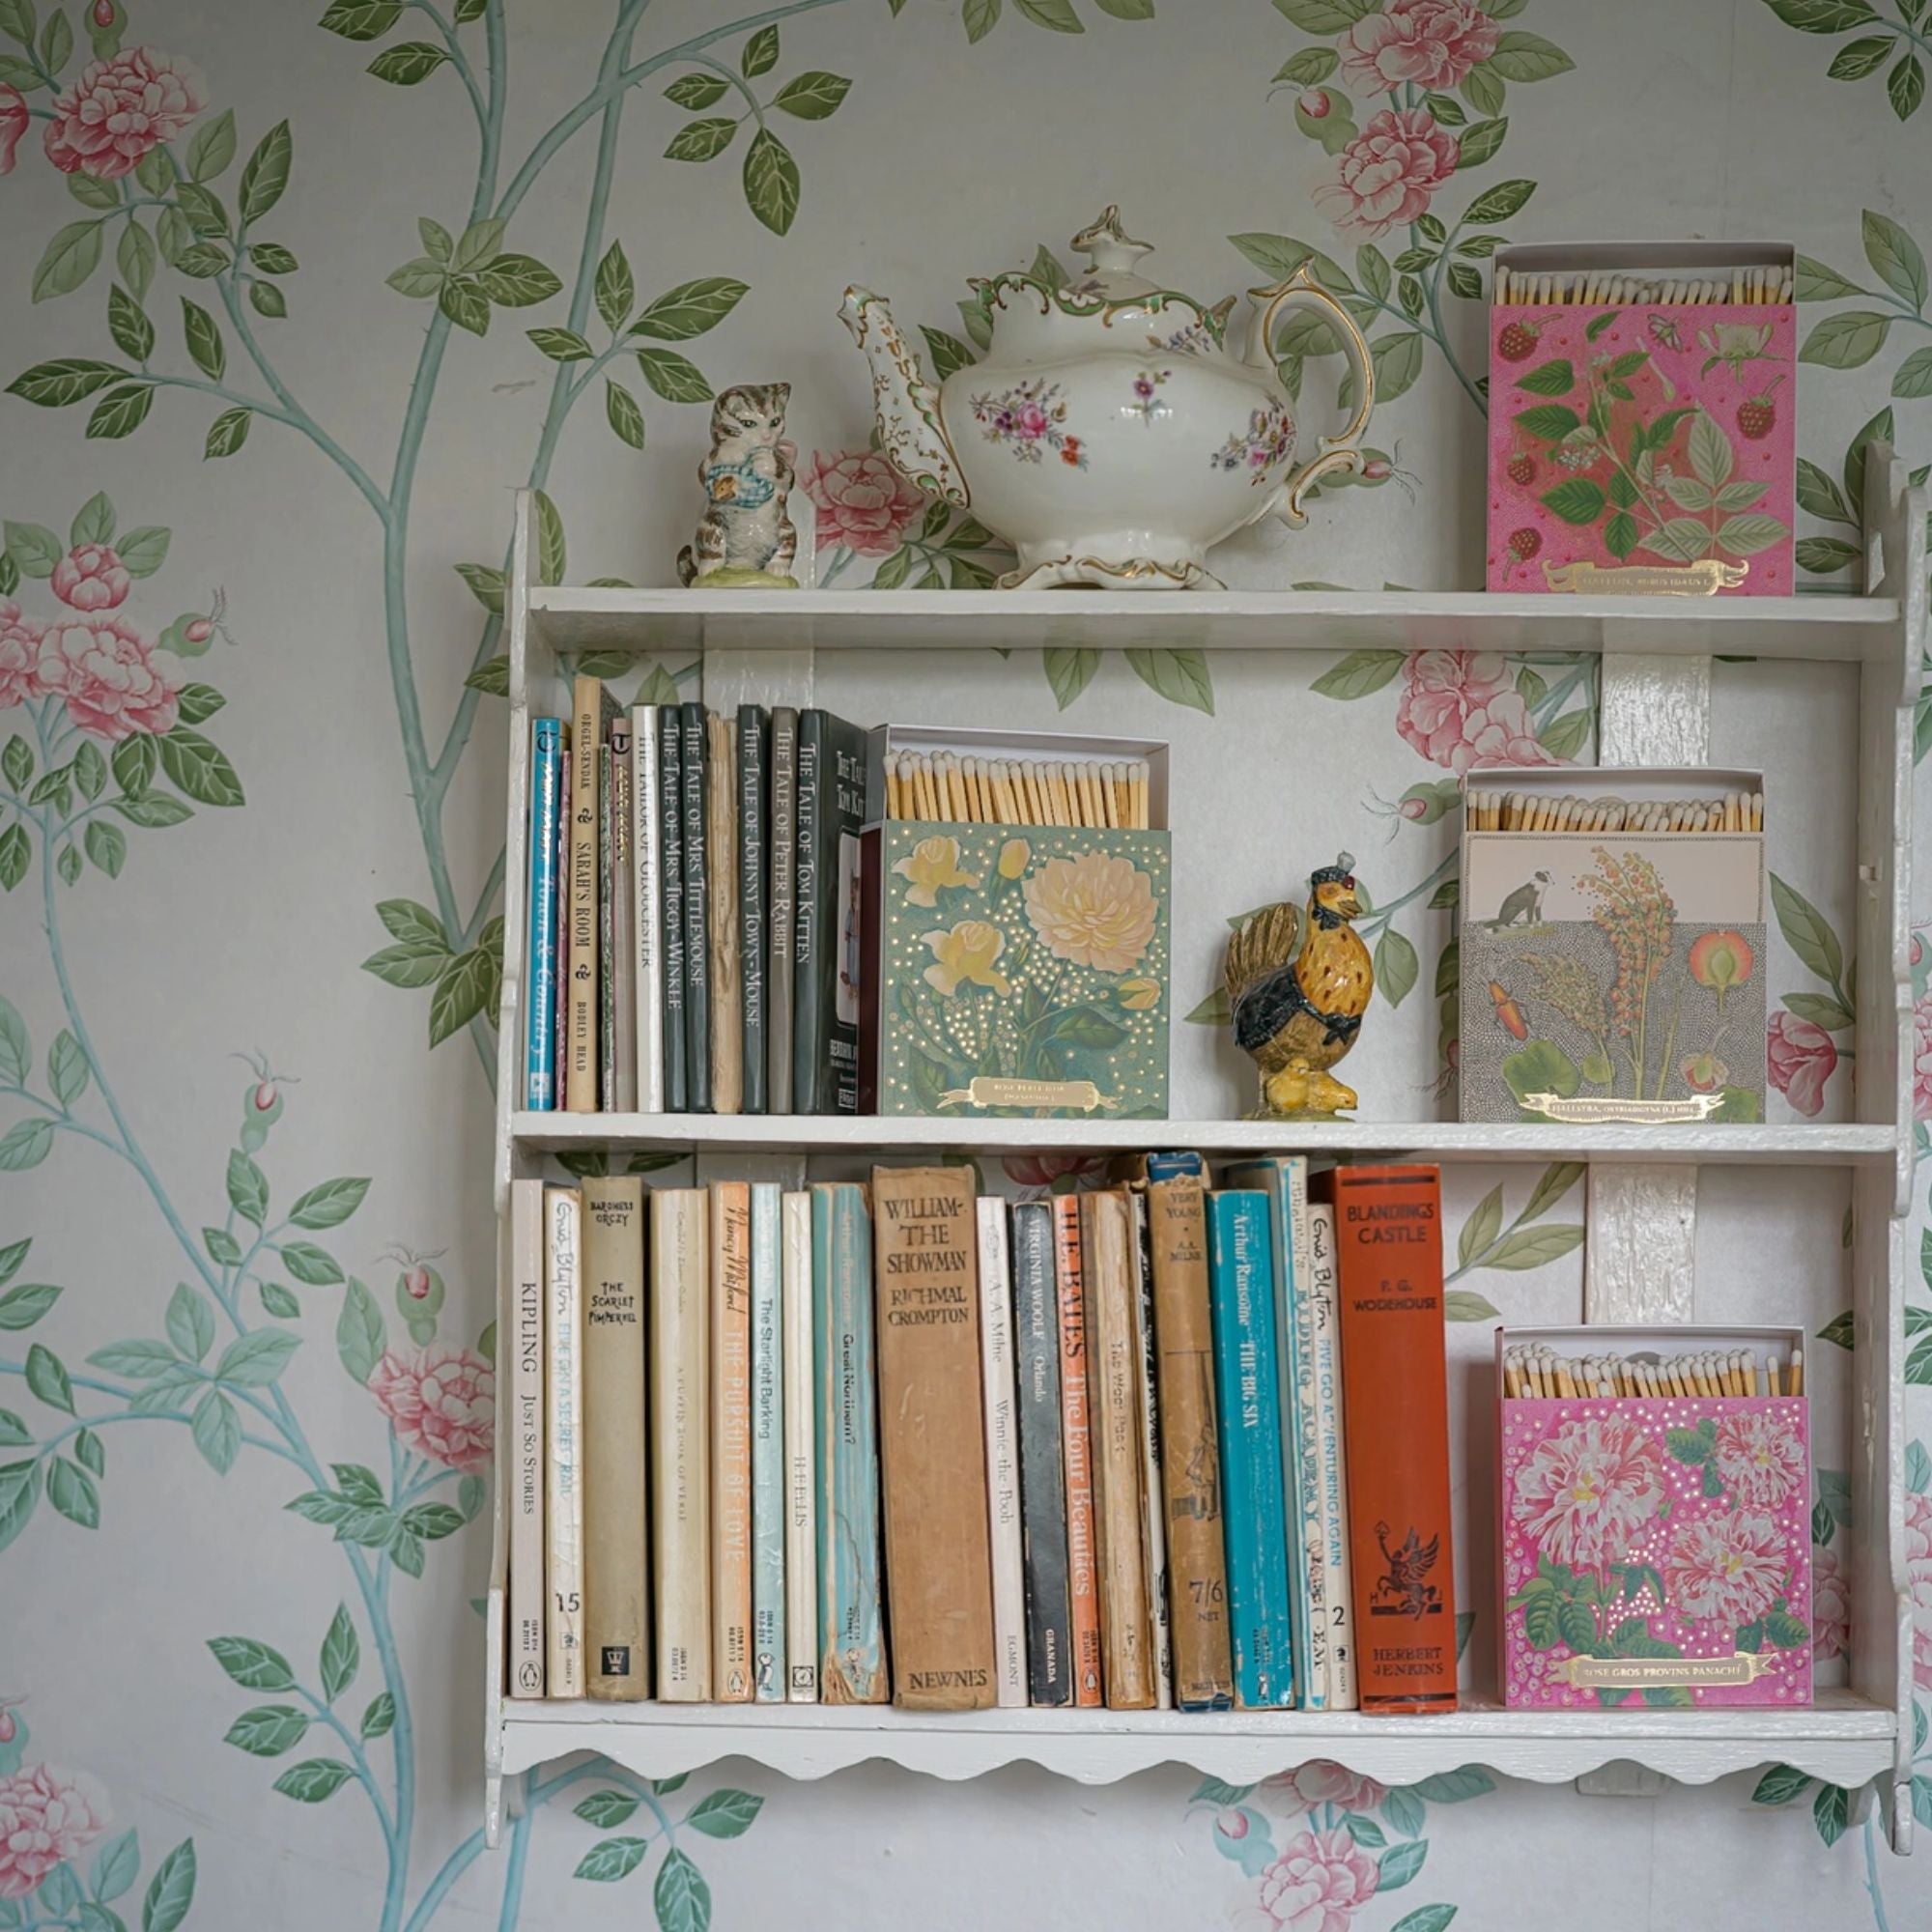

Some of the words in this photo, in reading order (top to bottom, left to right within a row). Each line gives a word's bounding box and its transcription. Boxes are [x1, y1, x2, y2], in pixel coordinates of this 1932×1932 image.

[580, 713, 591, 789] ORGEL-SENDAK
[638, 732, 655, 766] THE
[664, 724, 680, 757] THE
[687, 723, 703, 756] THE
[744, 724, 761, 758] THE
[776, 726, 793, 761] THE
[798, 743, 816, 777] THE
[639, 772, 655, 828] TAILOR
[664, 762, 680, 805] TALE
[687, 760, 703, 803] TALE
[744, 763, 761, 806] TALE
[776, 765, 793, 808] TALE
[664, 810, 678, 833] OF
[688, 809, 701, 832] OF
[745, 811, 758, 834] OF
[798, 781, 816, 826] TALE
[639, 833, 652, 852] OF
[776, 813, 791, 836] OF
[798, 831, 812, 854] OF
[576, 842, 591, 901] SARAH'S
[744, 837, 761, 908] JOHNNY
[775, 840, 791, 891] PETER
[797, 860, 815, 894] TOM
[575, 907, 591, 947] ROOM
[639, 861, 653, 968] GLOUCESTER
[689, 877, 705, 987] TITTLEMOUSE
[771, 898, 791, 958] RABBIT
[797, 900, 814, 964] KITTEN
[666, 882, 683, 1009] TIGGY-WINKLE
[739, 909, 762, 1028] TOWN-MOUSE
[529, 968, 554, 1057] Country
[577, 1001, 586, 1038] BODLEY
[576, 1046, 586, 1072] HEAD
[589, 1201, 634, 1212] BARONESS
[1170, 1191, 1199, 1204] VERY
[1347, 1203, 1435, 1222] BLANDINGS
[556, 1201, 573, 1246] Enid
[595, 1213, 629, 1227] ORCZY
[723, 1206, 749, 1254] Nancy
[897, 1224, 950, 1246] THE
[1233, 1213, 1249, 1264] Arthur
[1313, 1217, 1328, 1259] Enid
[1357, 1226, 1428, 1244] CASTLE
[886, 1250, 968, 1274] SHOWMAN
[1028, 1218, 1043, 1286] VIRGINIA
[551, 1253, 575, 1316] Blyton
[591, 1295, 636, 1310] SCARLET
[600, 1281, 624, 1295] THE
[723, 1255, 750, 1315] Mitford
[890, 1286, 967, 1306] RICHMAL
[1236, 1264, 1253, 1326] Ransome
[1311, 1267, 1332, 1331] Blyton
[1352, 1296, 1438, 1312] WODEHOUSE
[522, 1282, 538, 1374] KIPLING
[587, 1310, 638, 1325] PIMPERNEL
[760, 1298, 773, 1324] The
[887, 1307, 969, 1326] CROMPTON
[1031, 1287, 1045, 1341] WOOLF
[1062, 1270, 1085, 1358] BATES
[724, 1330, 745, 1366] THE
[758, 1327, 774, 1384] Starlight
[842, 1333, 854, 1372] Great
[991, 1321, 1006, 1363] Milne
[1239, 1341, 1257, 1372] THE
[1294, 1289, 1315, 1388] RIDING
[1319, 1338, 1331, 1371] FIVE
[1033, 1354, 1047, 1402] Orlando
[1065, 1374, 1088, 1418] The
[1240, 1375, 1258, 1401] BIG
[1321, 1374, 1333, 1400] GO
[520, 1394, 537, 1430] JUST
[724, 1377, 745, 1462] PURSUIT
[757, 1387, 773, 1439] Barking
[842, 1375, 857, 1445] Northern?
[1242, 1404, 1259, 1428] SIX
[523, 1433, 537, 1453] SO
[1066, 1425, 1089, 1484] Four
[1301, 1401, 1319, 1520] ACADEMY
[523, 1457, 537, 1516] STORIES
[724, 1474, 745, 1497] OF
[793, 1486, 808, 1527] ELLIS
[724, 1504, 745, 1561] LOVE
[1069, 1488, 1094, 1596] Beauties
[1328, 1516, 1342, 1567] AGAIN
[555, 1592, 580, 1612] 15
[1188, 1578, 1223, 1607] 7/6
[1197, 1610, 1220, 1622] NET
[1332, 1606, 1346, 1626] 2
[1007, 1634, 1020, 1687] EGMONT
[1045, 1629, 1057, 1684] GRANADA
[1372, 1646, 1443, 1662] HERBERT
[1372, 1662, 1445, 1676] JENKINS
[1611, 1667, 1641, 1678] GROS
[1643, 1666, 1690, 1678] PROVINS
[907, 1669, 987, 1690] NEWNES
